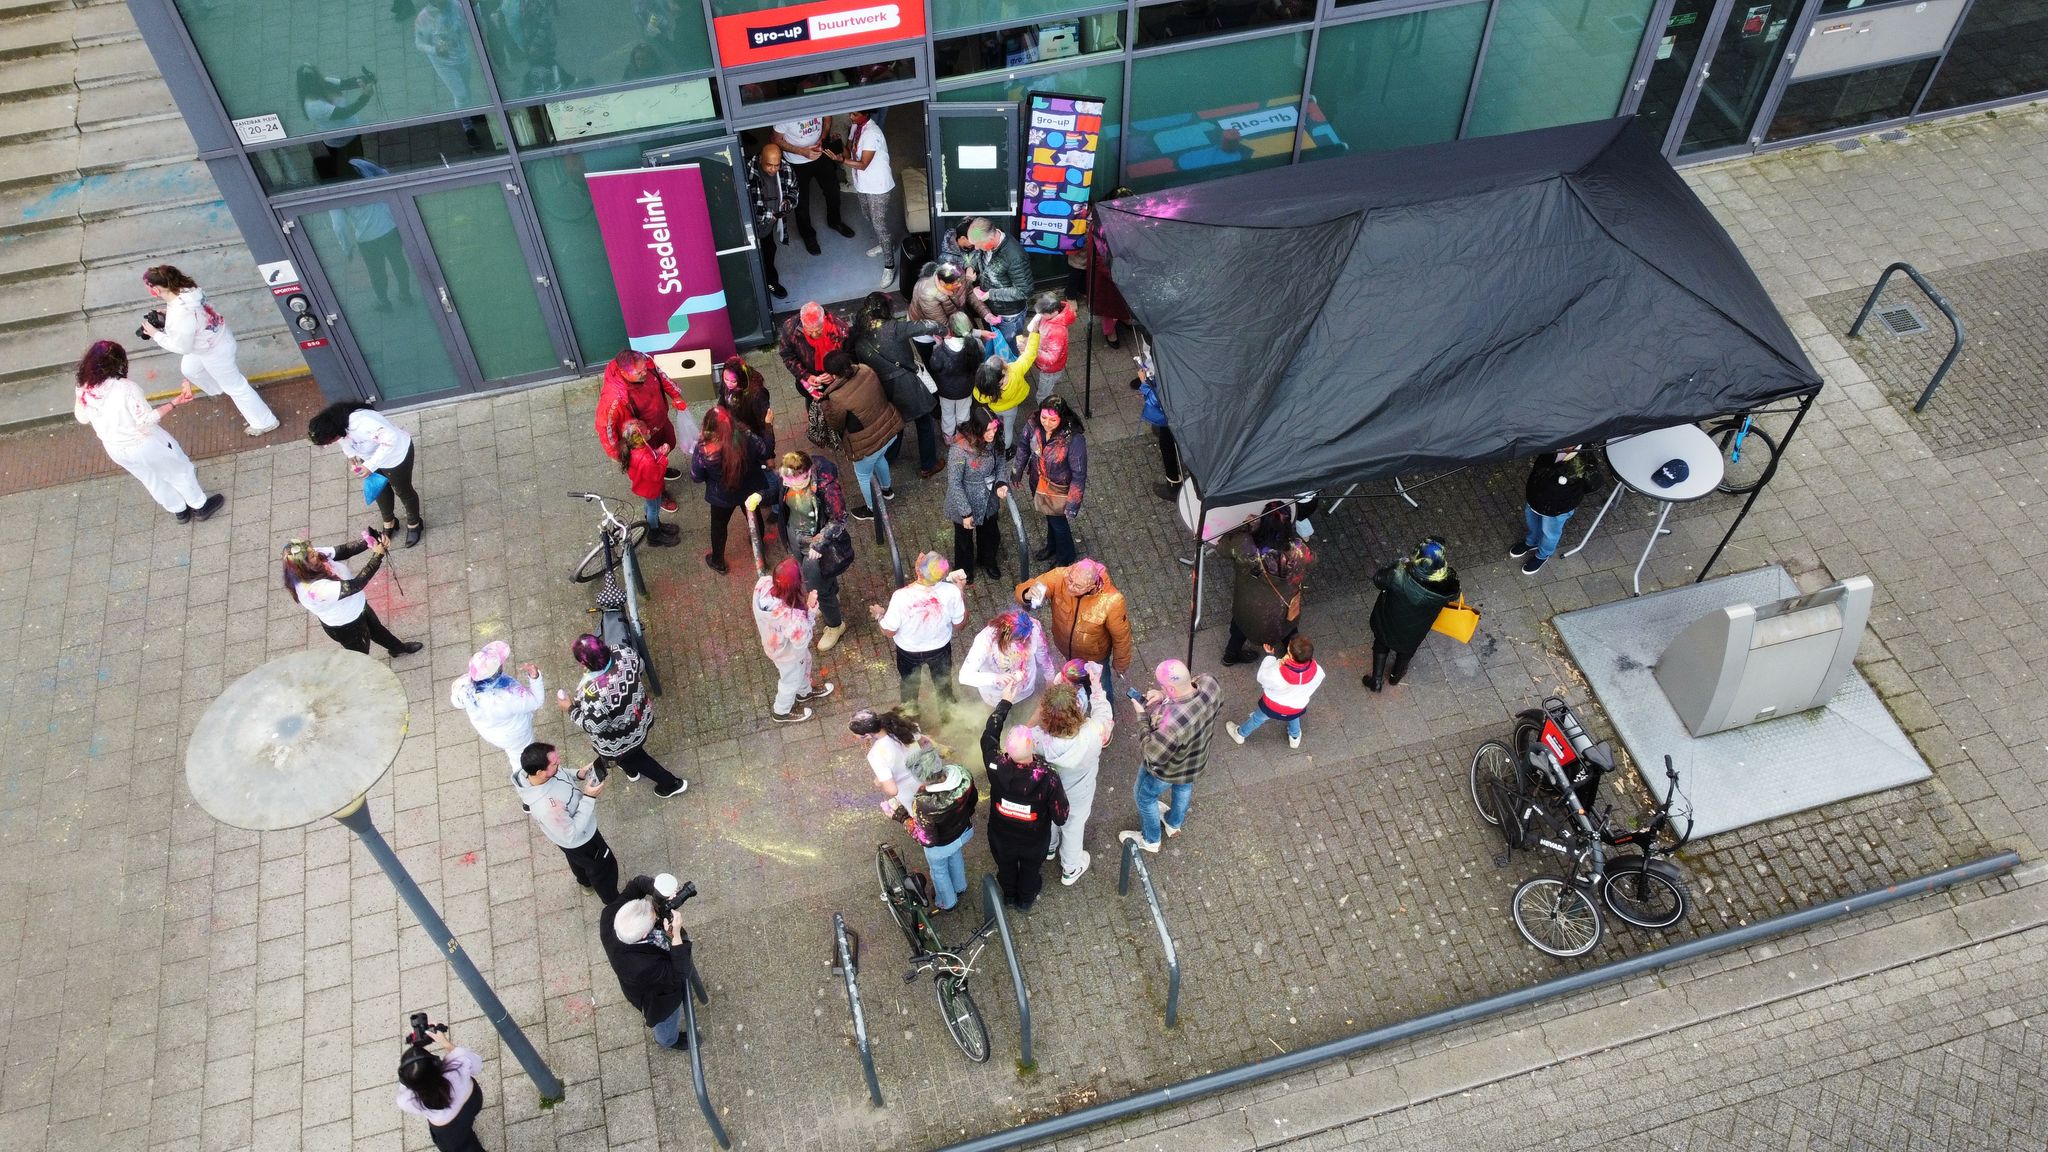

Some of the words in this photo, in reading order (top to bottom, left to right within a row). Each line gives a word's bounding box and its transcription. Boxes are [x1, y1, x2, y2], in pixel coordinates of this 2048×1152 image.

[754, 26, 802, 44] gro-up
[818, 12, 887, 31] buurtwerk
[234, 119, 262, 127] ZANZIBAR
[1036, 116, 1070, 126] gro-up
[248, 123, 279, 135] 20-24
[636, 189, 682, 295] Stedelink
[1540, 838, 1568, 853] NEVADA
